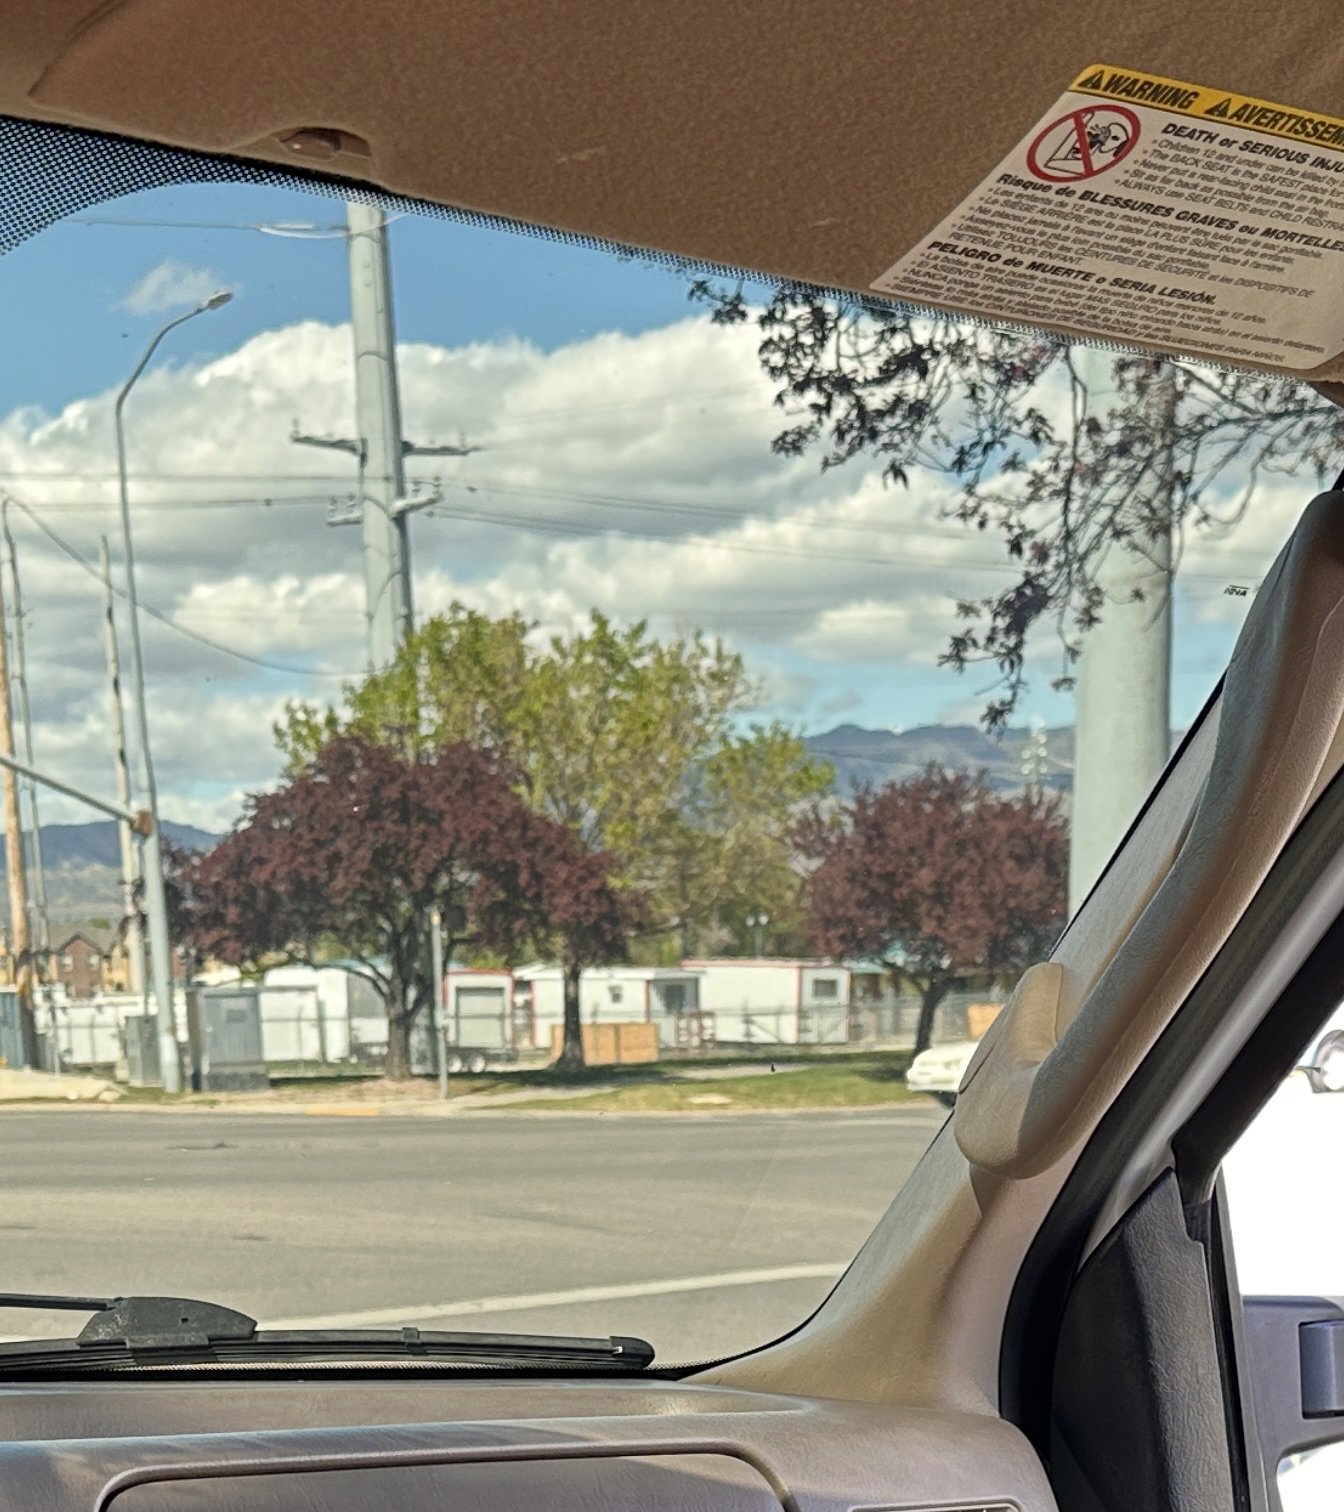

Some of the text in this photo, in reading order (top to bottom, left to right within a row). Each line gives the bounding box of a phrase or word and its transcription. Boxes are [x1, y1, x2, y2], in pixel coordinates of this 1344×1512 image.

[1102, 73, 1199, 110] WARNING
[1162, 123, 1219, 143] DEATH
[1218, 138, 1238, 148] or
[1239, 141, 1310, 164] SERIOUS
[997, 174, 1052, 192] Risque
[1055, 186, 1076, 198] de
[1079, 191, 1174, 217] BLESSURES
[1175, 211, 1239, 230] GRAVES
[1238, 225, 1260, 235] ou
[928, 241, 1001, 262] PELIGRO
[1002, 257, 1024, 268] de
[1026, 261, 1095, 281] MUERTE
[1109, 278, 1156, 293] SERIA
